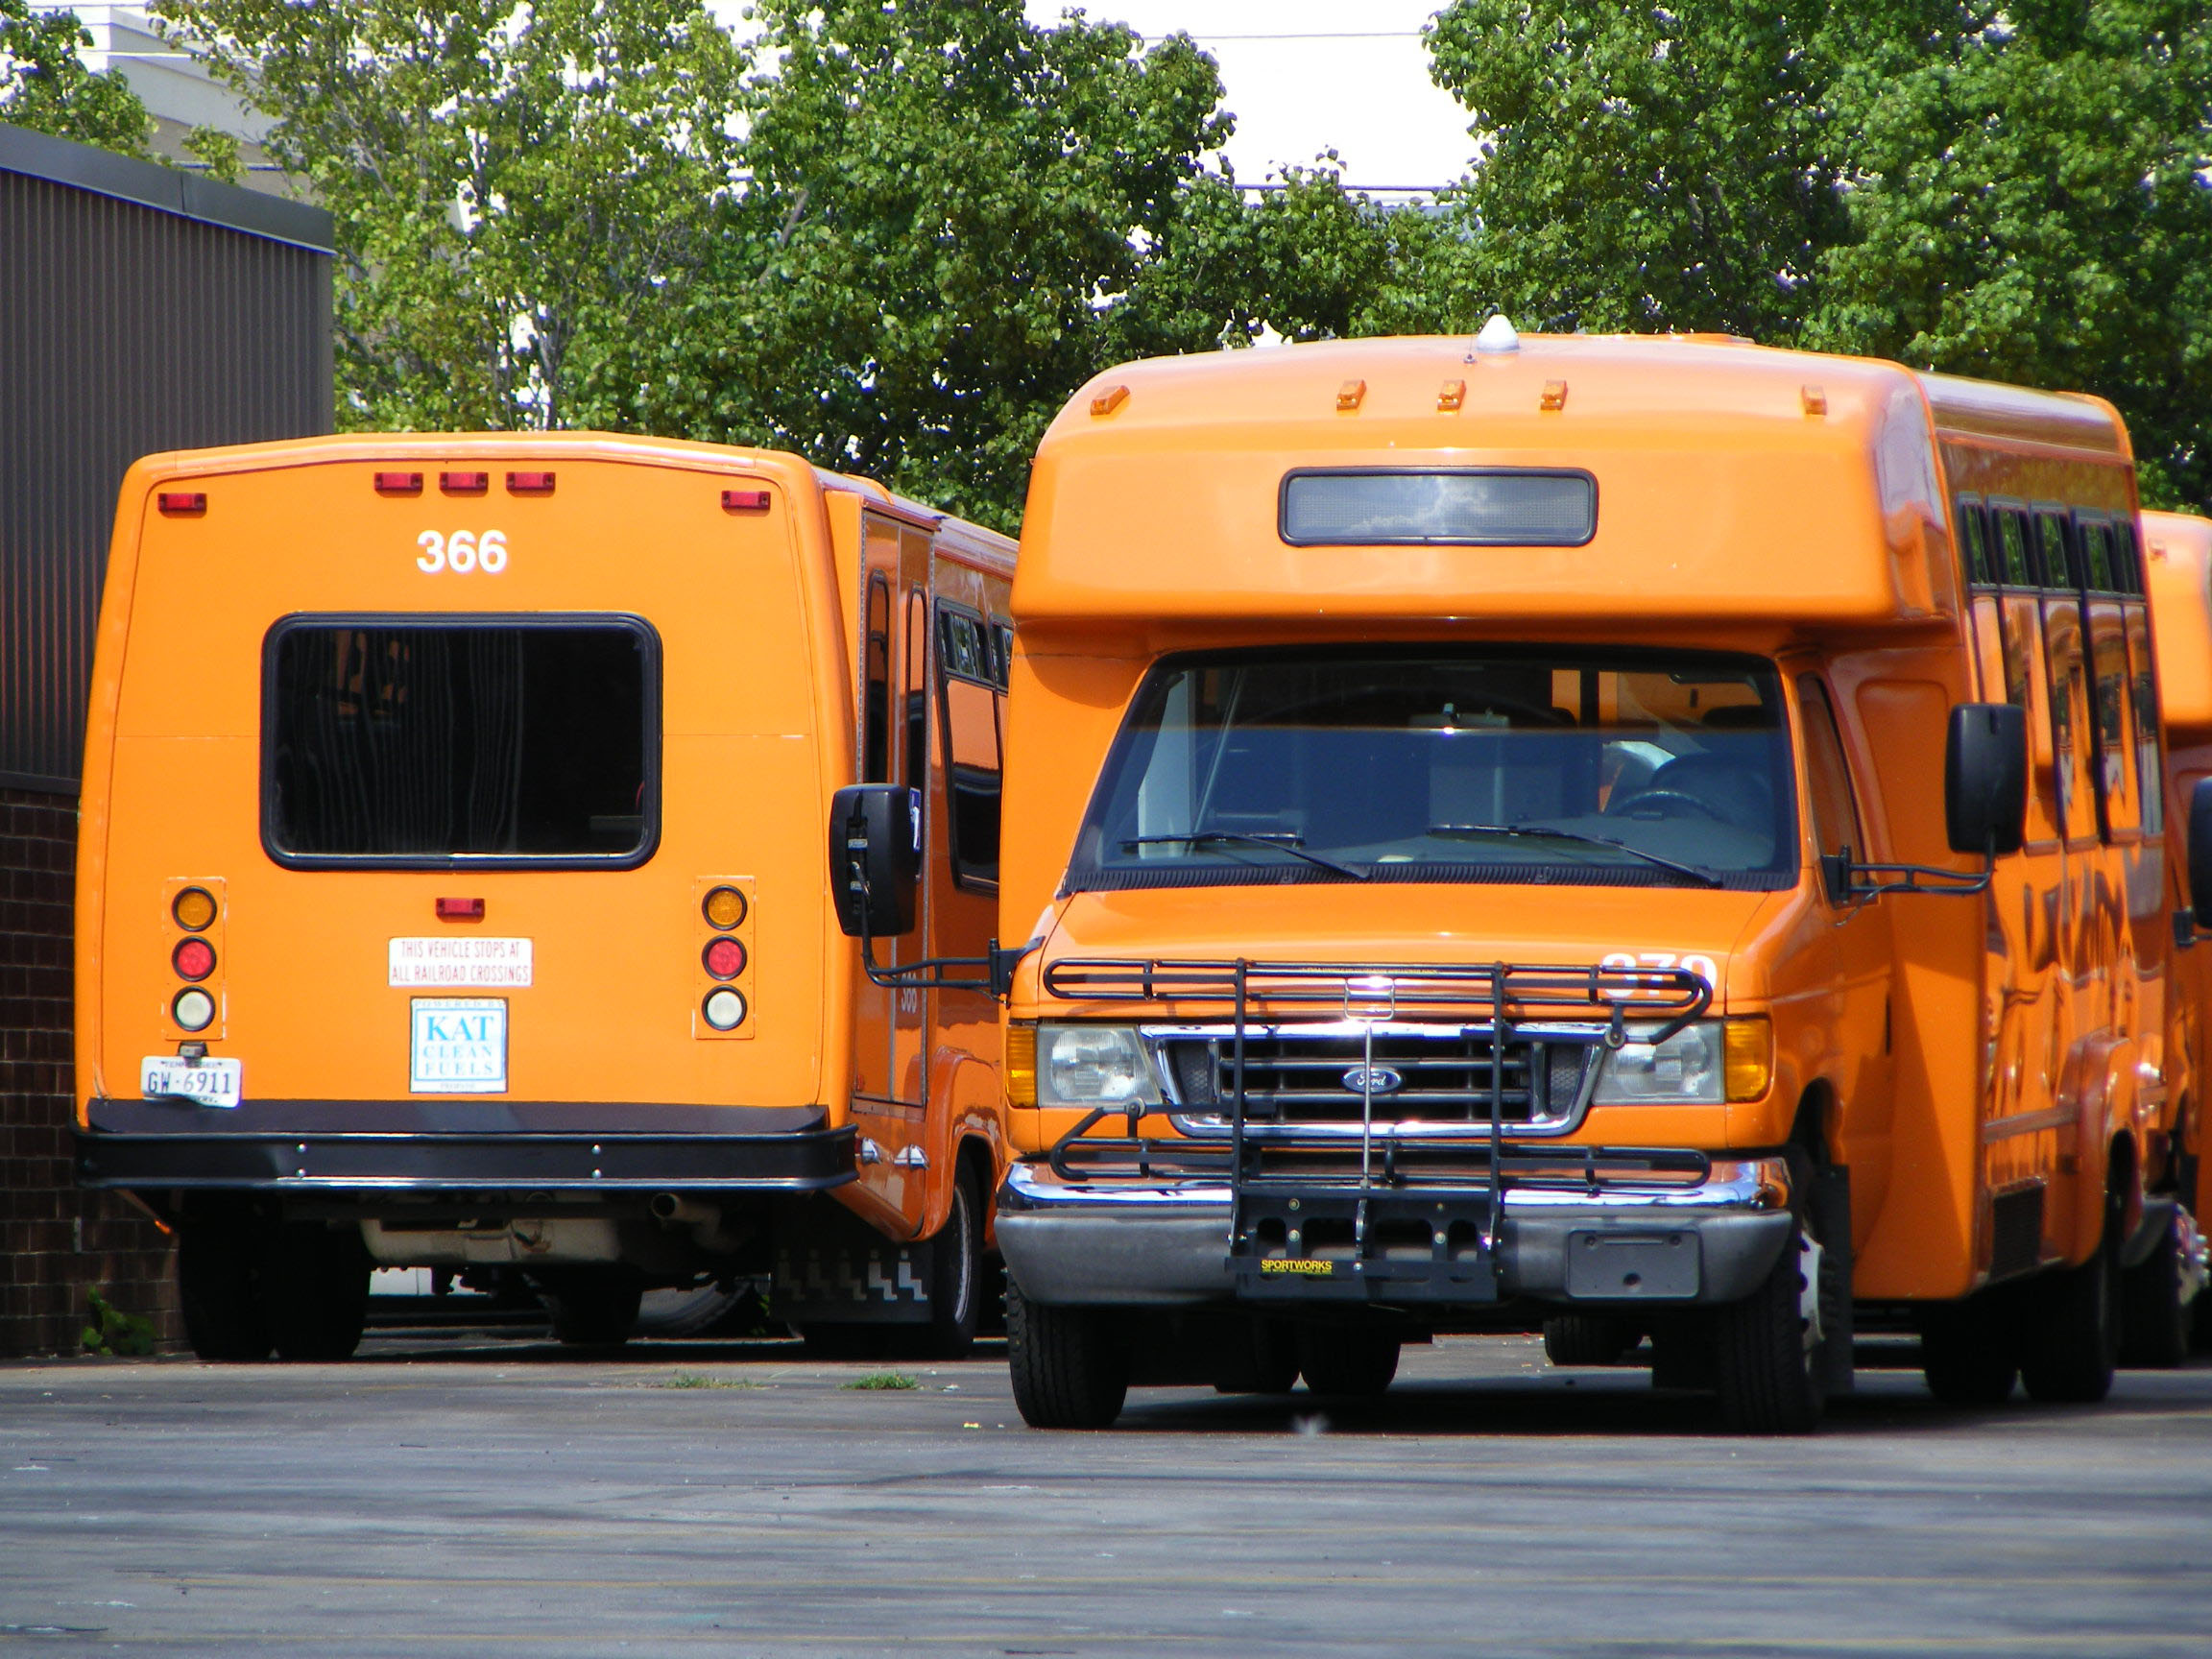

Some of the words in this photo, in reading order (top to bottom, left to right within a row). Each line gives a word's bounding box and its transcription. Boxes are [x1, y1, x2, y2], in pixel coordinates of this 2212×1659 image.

[416, 529, 507, 574] 366
[401, 941, 423, 958] THIS
[428, 941, 470, 958] VEHICLE
[474, 941, 506, 958] STOPS
[509, 941, 520, 958] AT
[392, 965, 411, 982] ALL
[415, 965, 467, 982] RAILROAD
[470, 965, 529, 982] CROSSINGS
[426, 1016, 494, 1042] KAT
[422, 1046, 493, 1059] CLEAN
[424, 1062, 493, 1076] FUELS
[1357, 1072, 1387, 1086] Frd
[1261, 1259, 1333, 1270] SPORTWORKS
